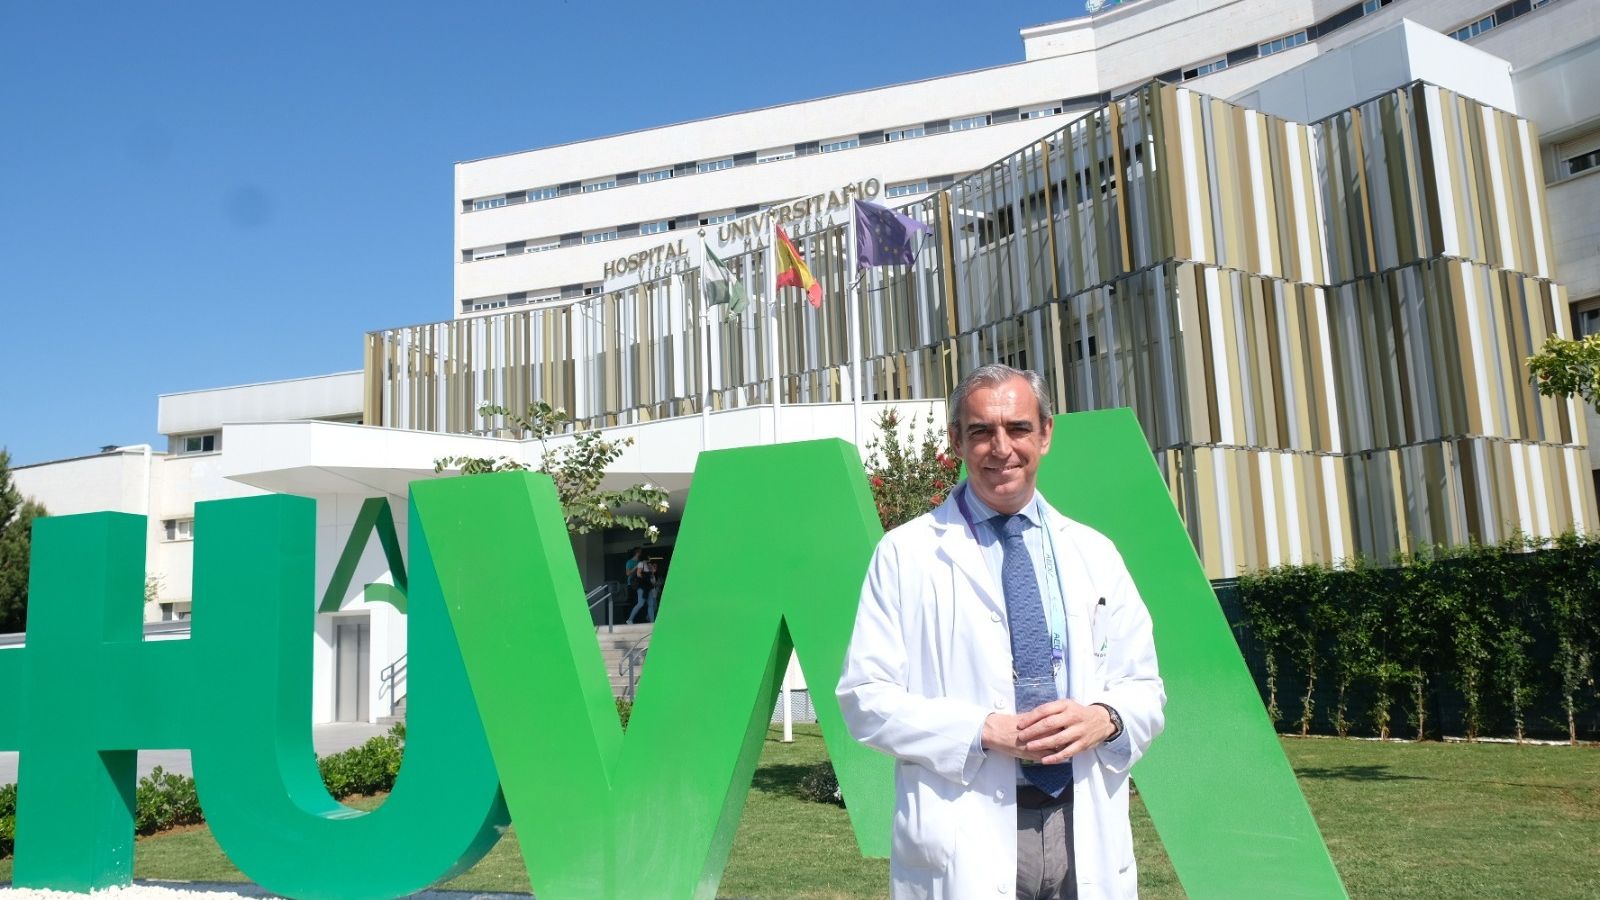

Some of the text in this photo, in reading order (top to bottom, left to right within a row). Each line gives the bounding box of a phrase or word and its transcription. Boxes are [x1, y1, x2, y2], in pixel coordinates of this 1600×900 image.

[604, 239, 688, 278] HOSPITAL
[638, 215, 836, 282] VIRGEN MARENA
